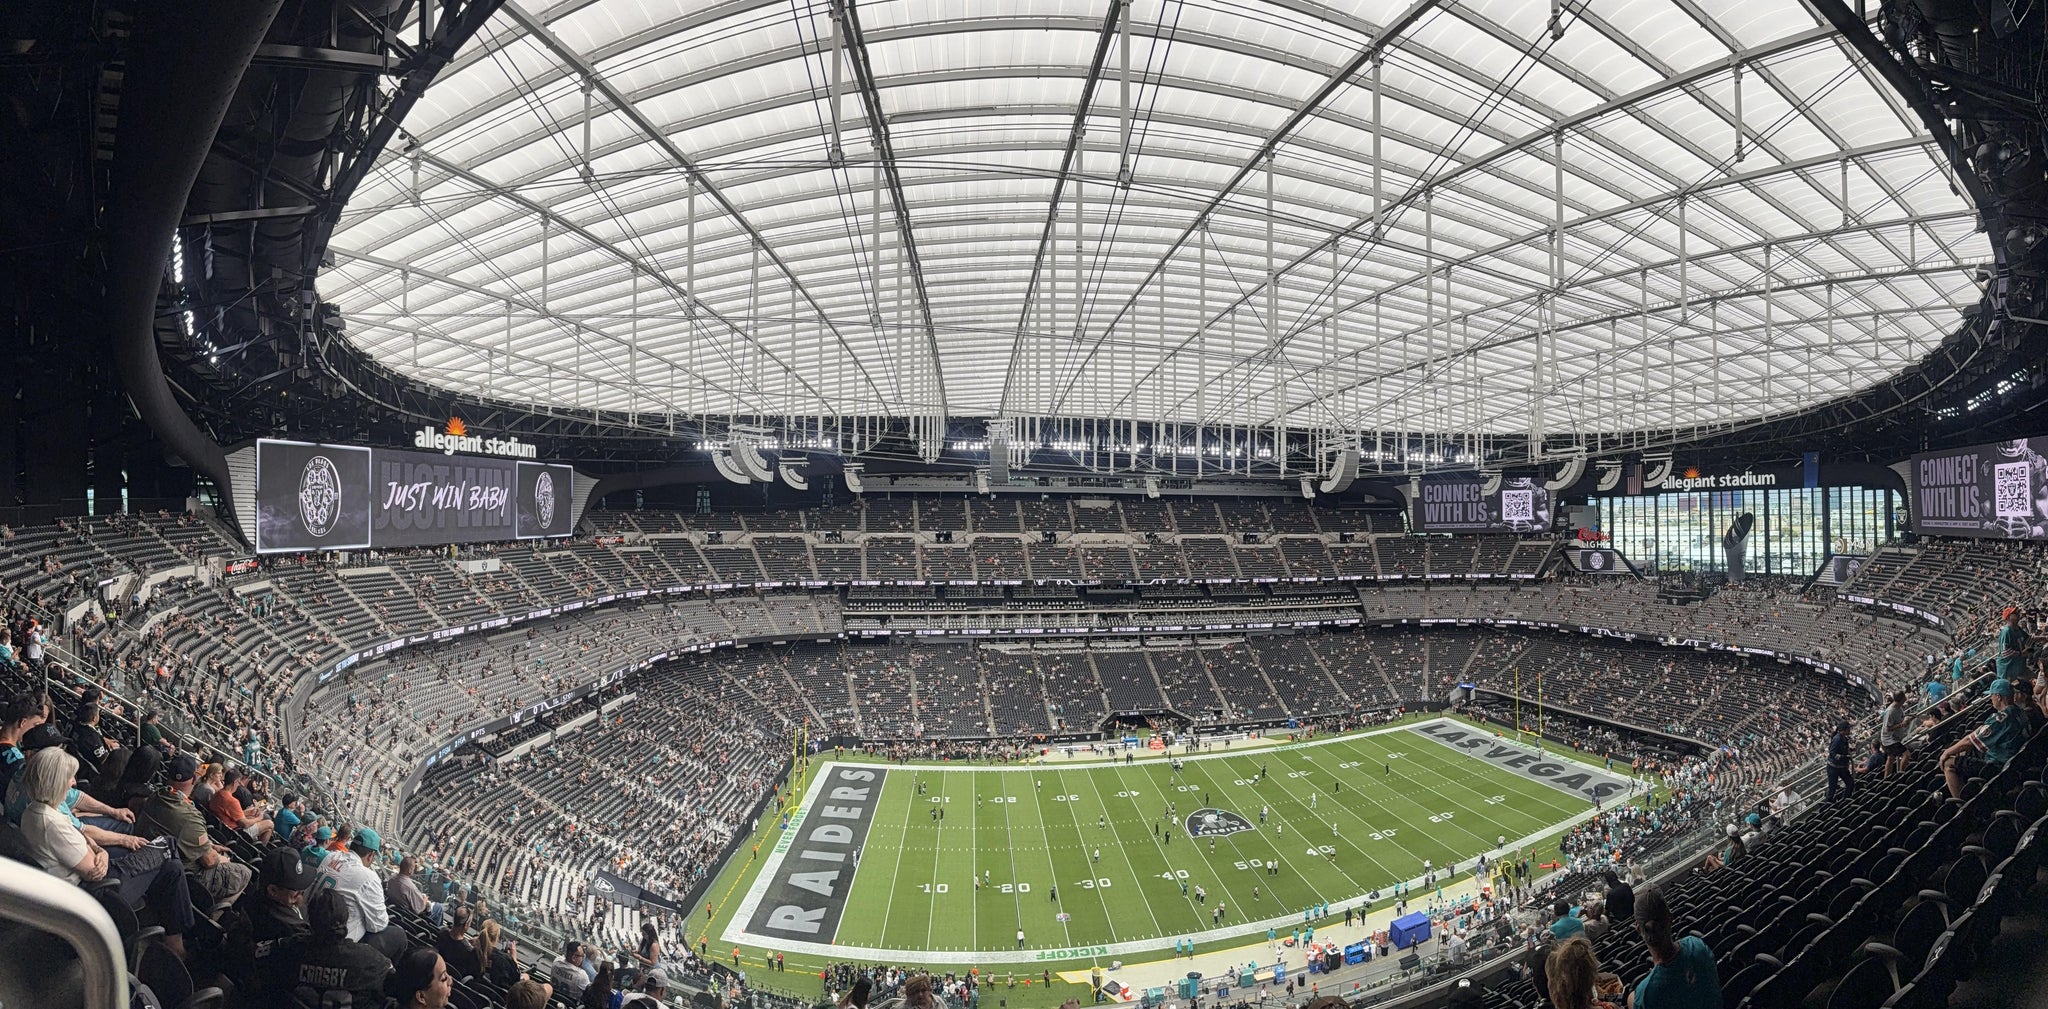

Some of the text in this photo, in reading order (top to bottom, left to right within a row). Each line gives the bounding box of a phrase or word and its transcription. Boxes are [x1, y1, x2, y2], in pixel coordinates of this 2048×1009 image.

[415, 426, 537, 458] allegiant stadium
[1920, 454, 1978, 486] CONNECT
[1662, 471, 1775, 491] allegiant stadium
[383, 480, 508, 518] JUST WIN BABY
[1920, 485, 1979, 518] WITH US
[1424, 502, 1488, 522] WITH US
[1577, 527, 1612, 542] Coors
[1418, 724, 1624, 797] LAS VEGAS
[1428, 811, 1454, 823] 20
[775, 831, 794, 854] NEVER
[1368, 828, 1396, 840] 30
[765, 769, 875, 933] RAIDERS
[1234, 858, 1263, 871] 50
[1081, 878, 1112, 889] 30
[1161, 869, 1190, 881] 40
[923, 883, 949, 894] 10
[1001, 882, 1031, 893] 20
[1036, 946, 1108, 961] KICKOFF
[300, 964, 348, 987] CROSBY
